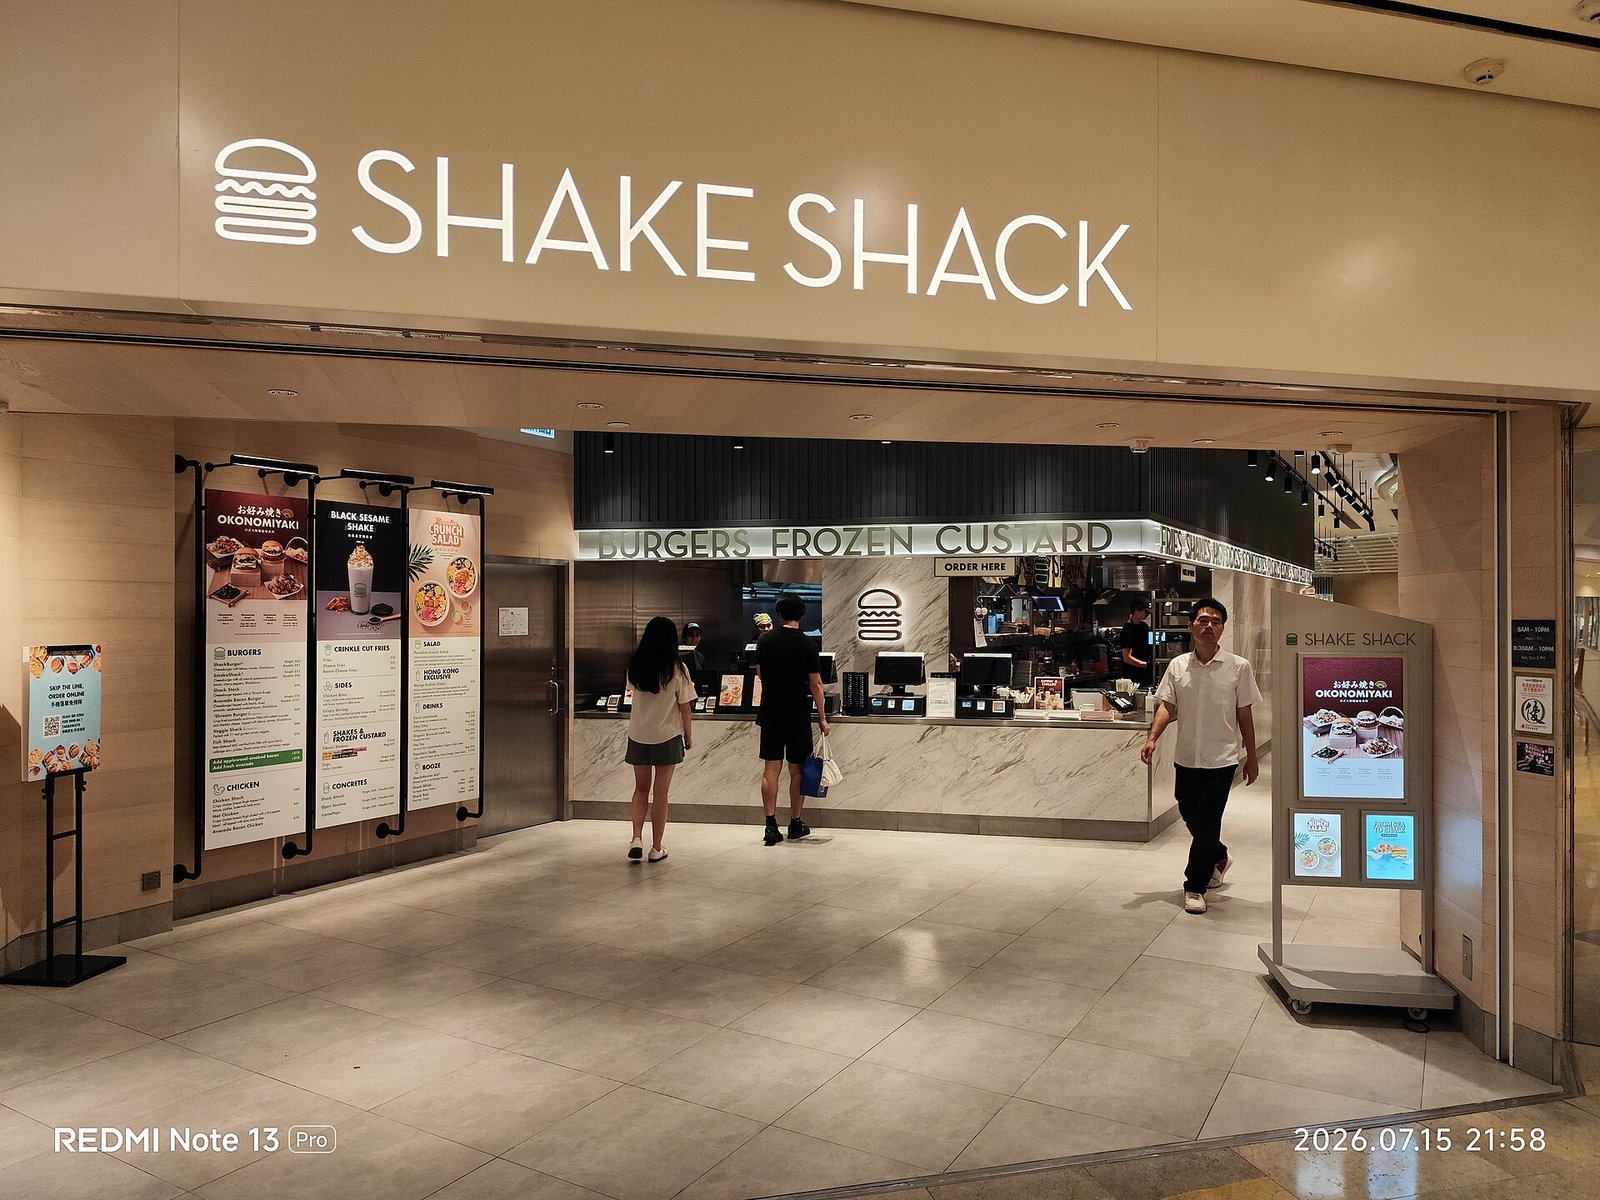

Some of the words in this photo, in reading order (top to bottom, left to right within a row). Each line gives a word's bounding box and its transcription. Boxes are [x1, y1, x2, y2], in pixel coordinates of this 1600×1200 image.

[351, 149, 756, 282] SHAKE
[783, 193, 1133, 310] SHACK
[238, 504, 281, 518] お好み焼き
[330, 510, 357, 520] BLACK
[360, 514, 390, 524] SESAME
[218, 514, 299, 530] OKONOMIYAKI
[347, 522, 374, 532] SHAKE
[429, 523, 464, 537] CRUNCH
[432, 533, 461, 546] SALAD
[599, 529, 751, 560] BURGERS
[772, 526, 912, 557] FROZEN
[935, 522, 1112, 554] CUSTARD
[944, 563, 978, 571] ORDER
[982, 562, 1006, 570] HERE
[1304, 632, 1356, 646] SHAKE
[1362, 632, 1416, 646] SHACK
[1333, 680, 1375, 689] お好み焼き
[1315, 690, 1392, 698] OKONOMIYAKI
[333, 729, 357, 737] SHAKES
[360, 732, 387, 740] CUSTARD
[227, 781, 260, 792] CHICKEN
[332, 779, 368, 790] CONCRETES
